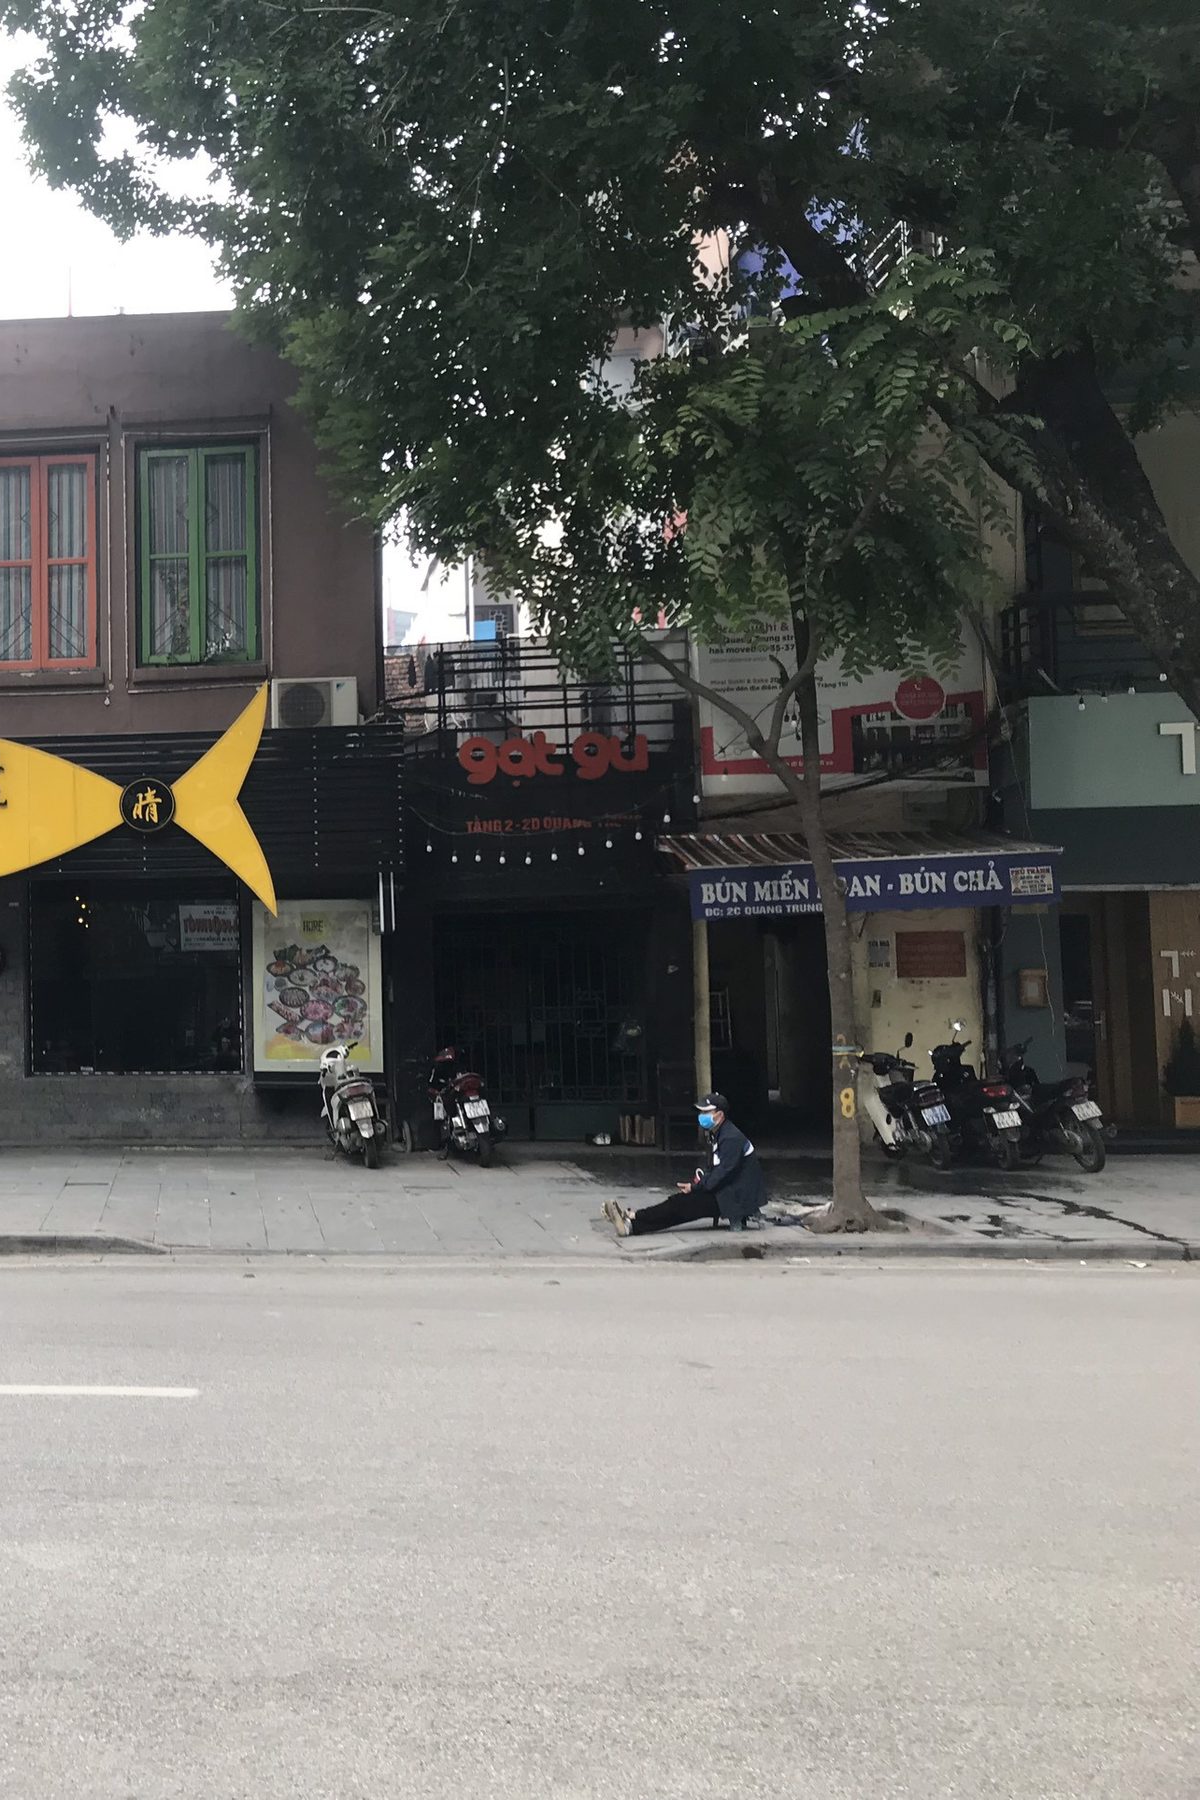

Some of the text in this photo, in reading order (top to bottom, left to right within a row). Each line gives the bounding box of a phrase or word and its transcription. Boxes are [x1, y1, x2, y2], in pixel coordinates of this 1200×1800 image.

[709, 646, 724, 655] has
[504, 819, 513, 832] 2
[701, 876, 747, 904] BÚN
[754, 870, 809, 902] MIẾN
[899, 866, 947, 895] BÚN
[953, 860, 1003, 892] CHẢ
[727, 906, 741, 916] 2C
[745, 904, 783, 915] QUANG
[786, 902, 823, 913] TRUNG
[841, 1088, 855, 1118] 8
